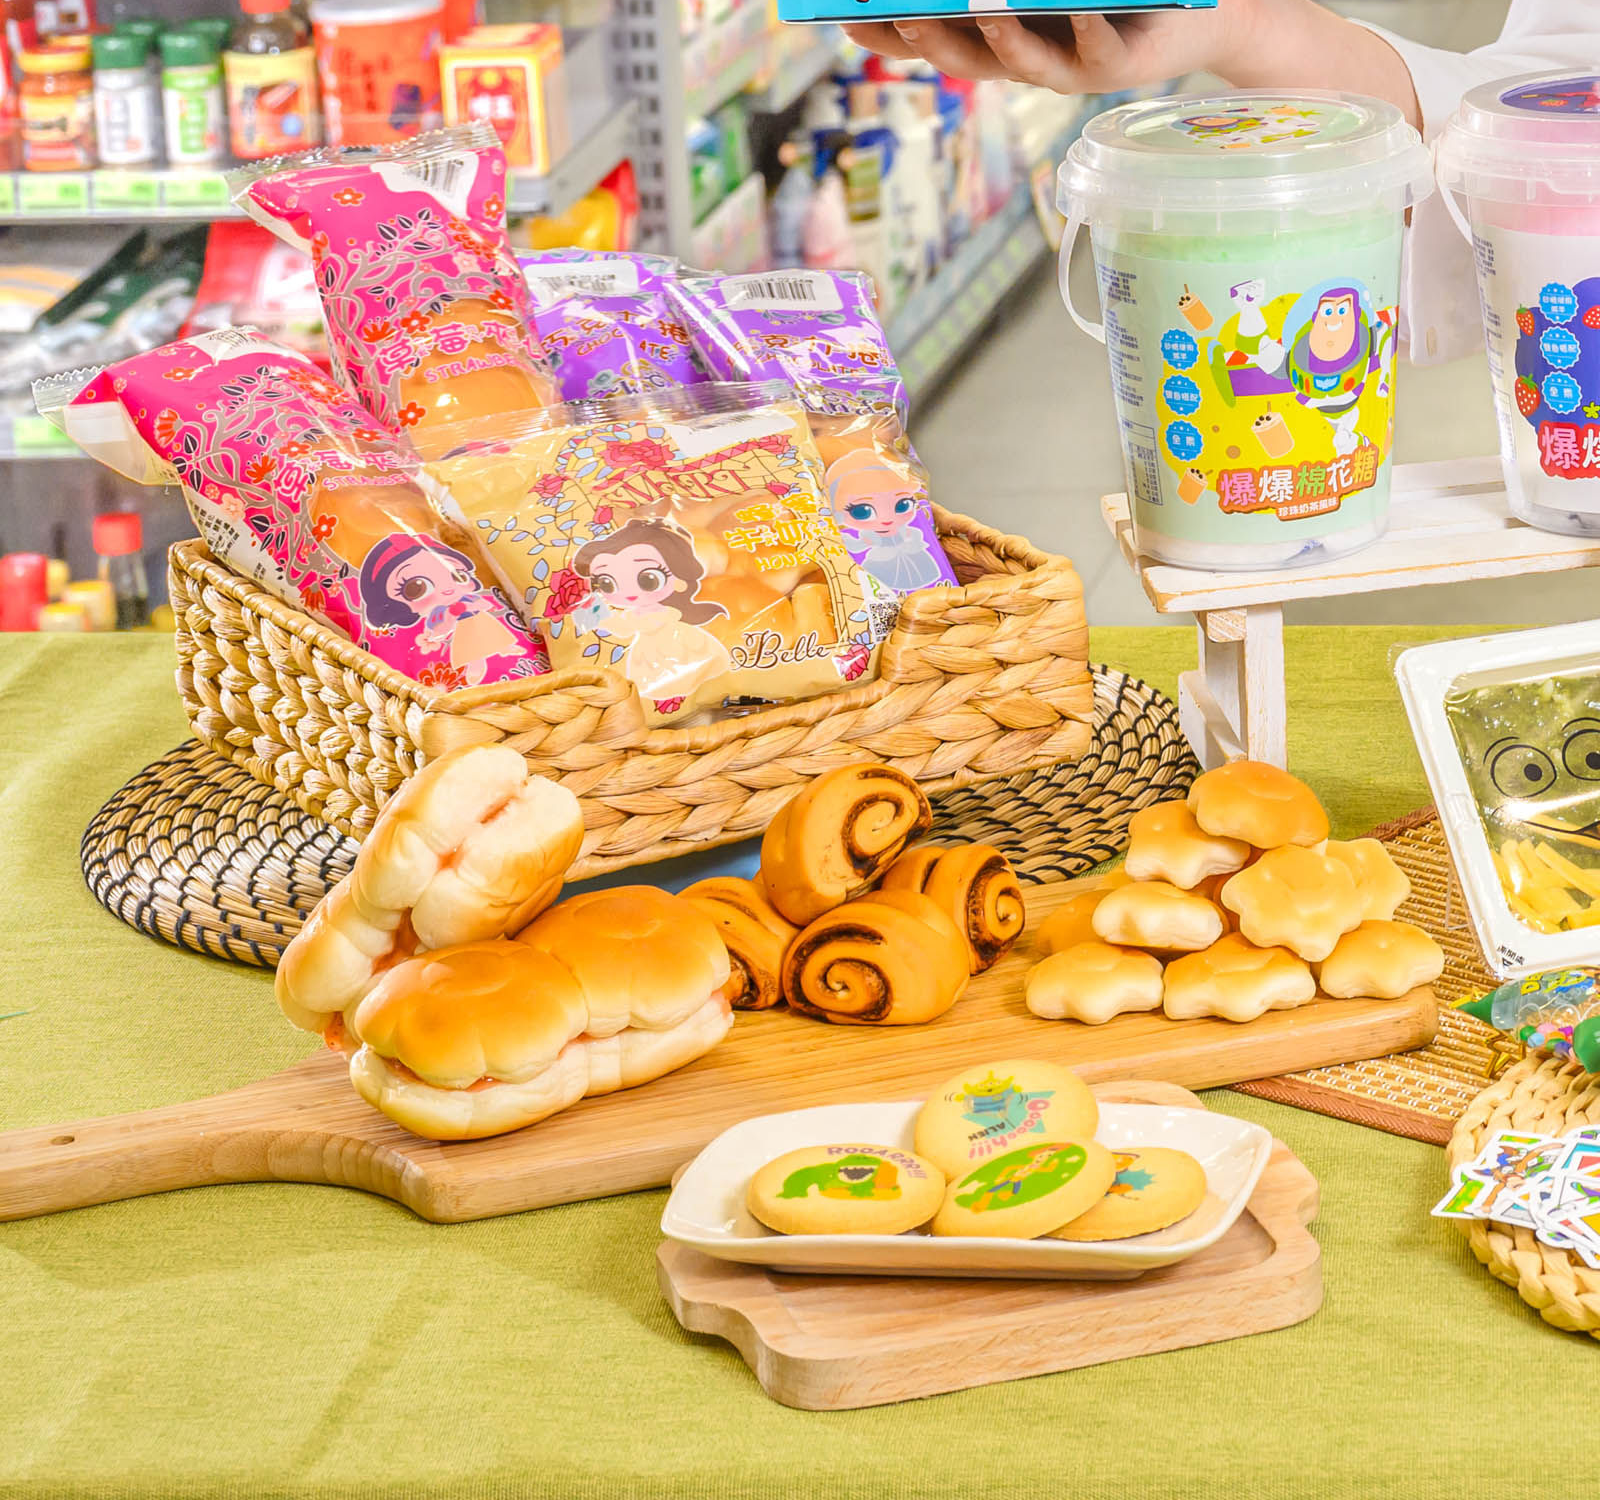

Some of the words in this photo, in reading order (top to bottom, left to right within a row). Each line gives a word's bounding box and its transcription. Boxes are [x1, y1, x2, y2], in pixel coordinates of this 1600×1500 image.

[1220, 444, 1378, 508] 爆爆棉花糖
[1277, 499, 1338, 518] 珍珠奶茶風味
[754, 549, 821, 573] HONEY
[731, 630, 832, 671] Belle
